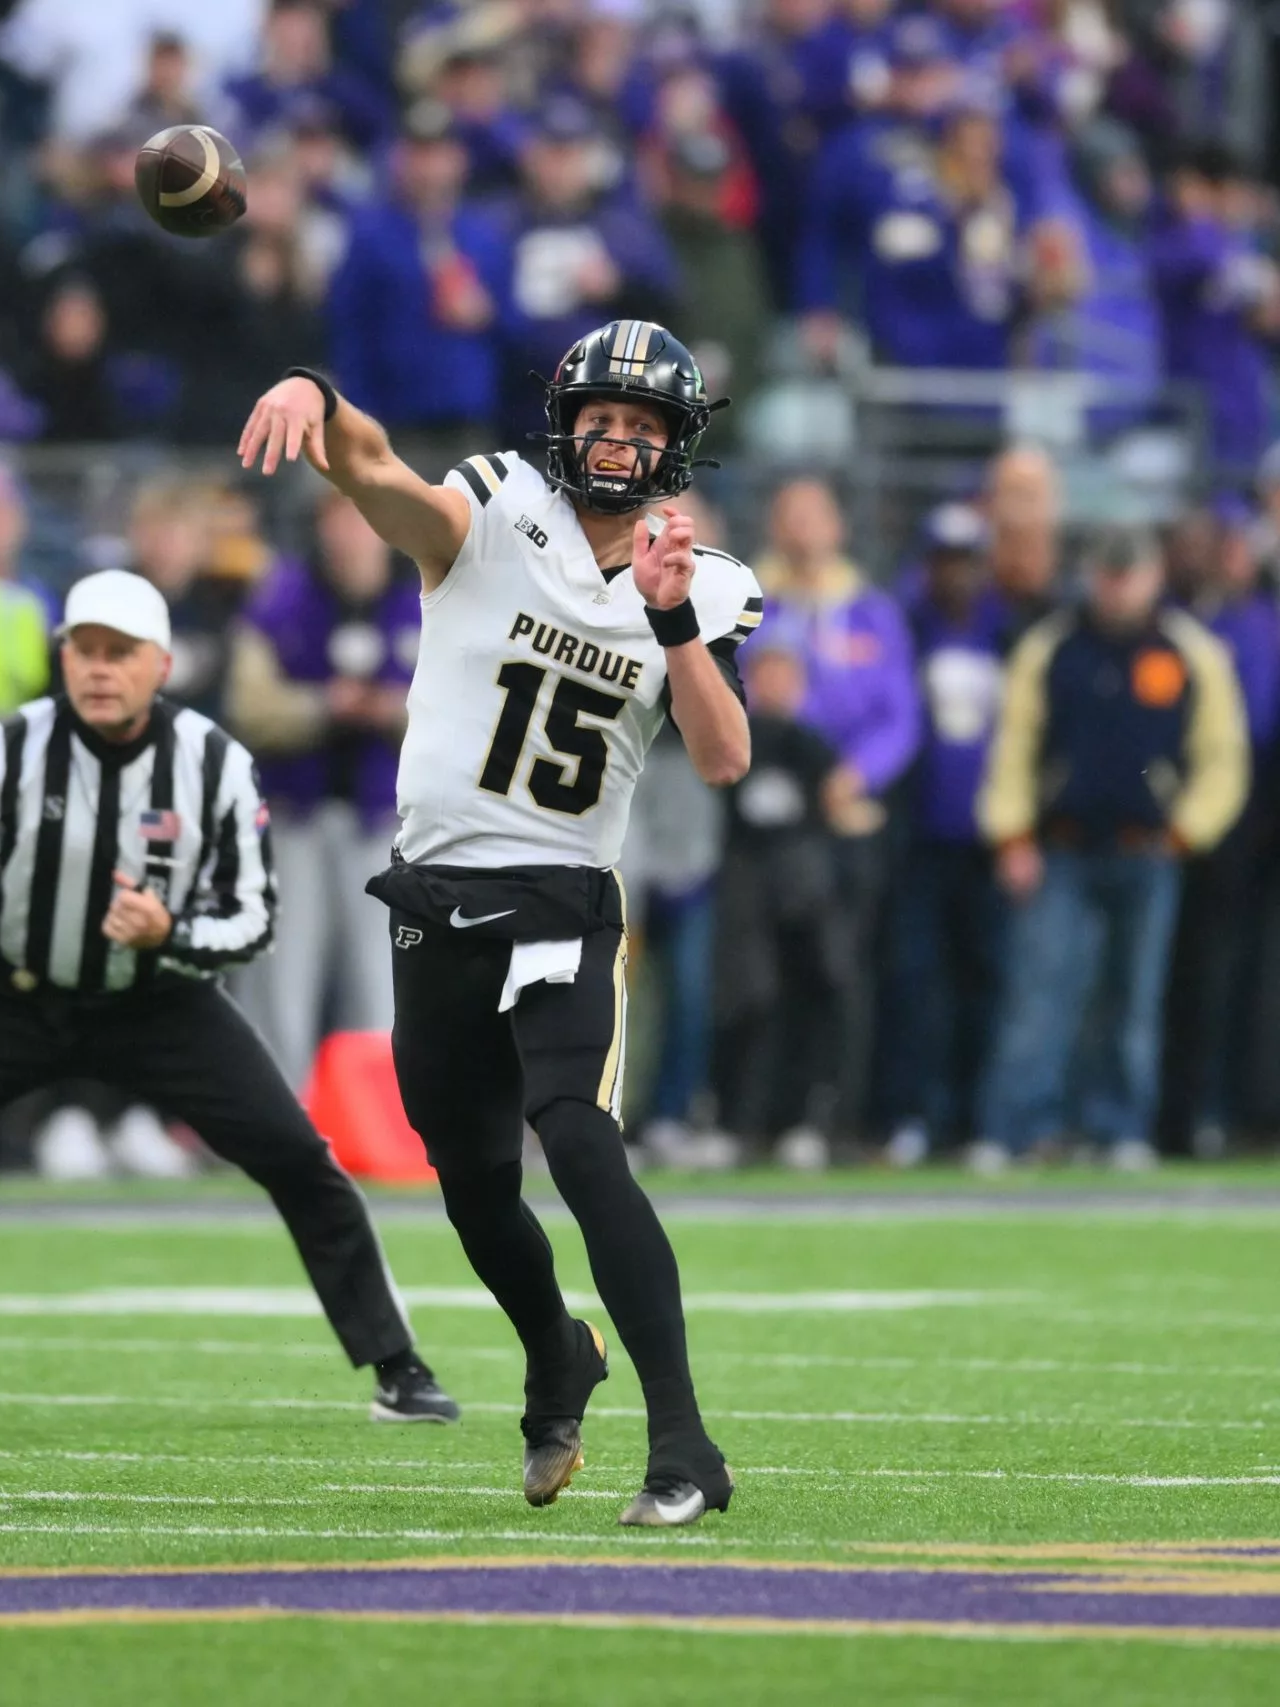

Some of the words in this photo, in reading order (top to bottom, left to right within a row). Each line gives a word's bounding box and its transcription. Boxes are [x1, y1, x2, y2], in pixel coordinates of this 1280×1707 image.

[508, 612, 644, 690] PURDUE
[477, 660, 629, 818] 15
[396, 925, 423, 950] P
